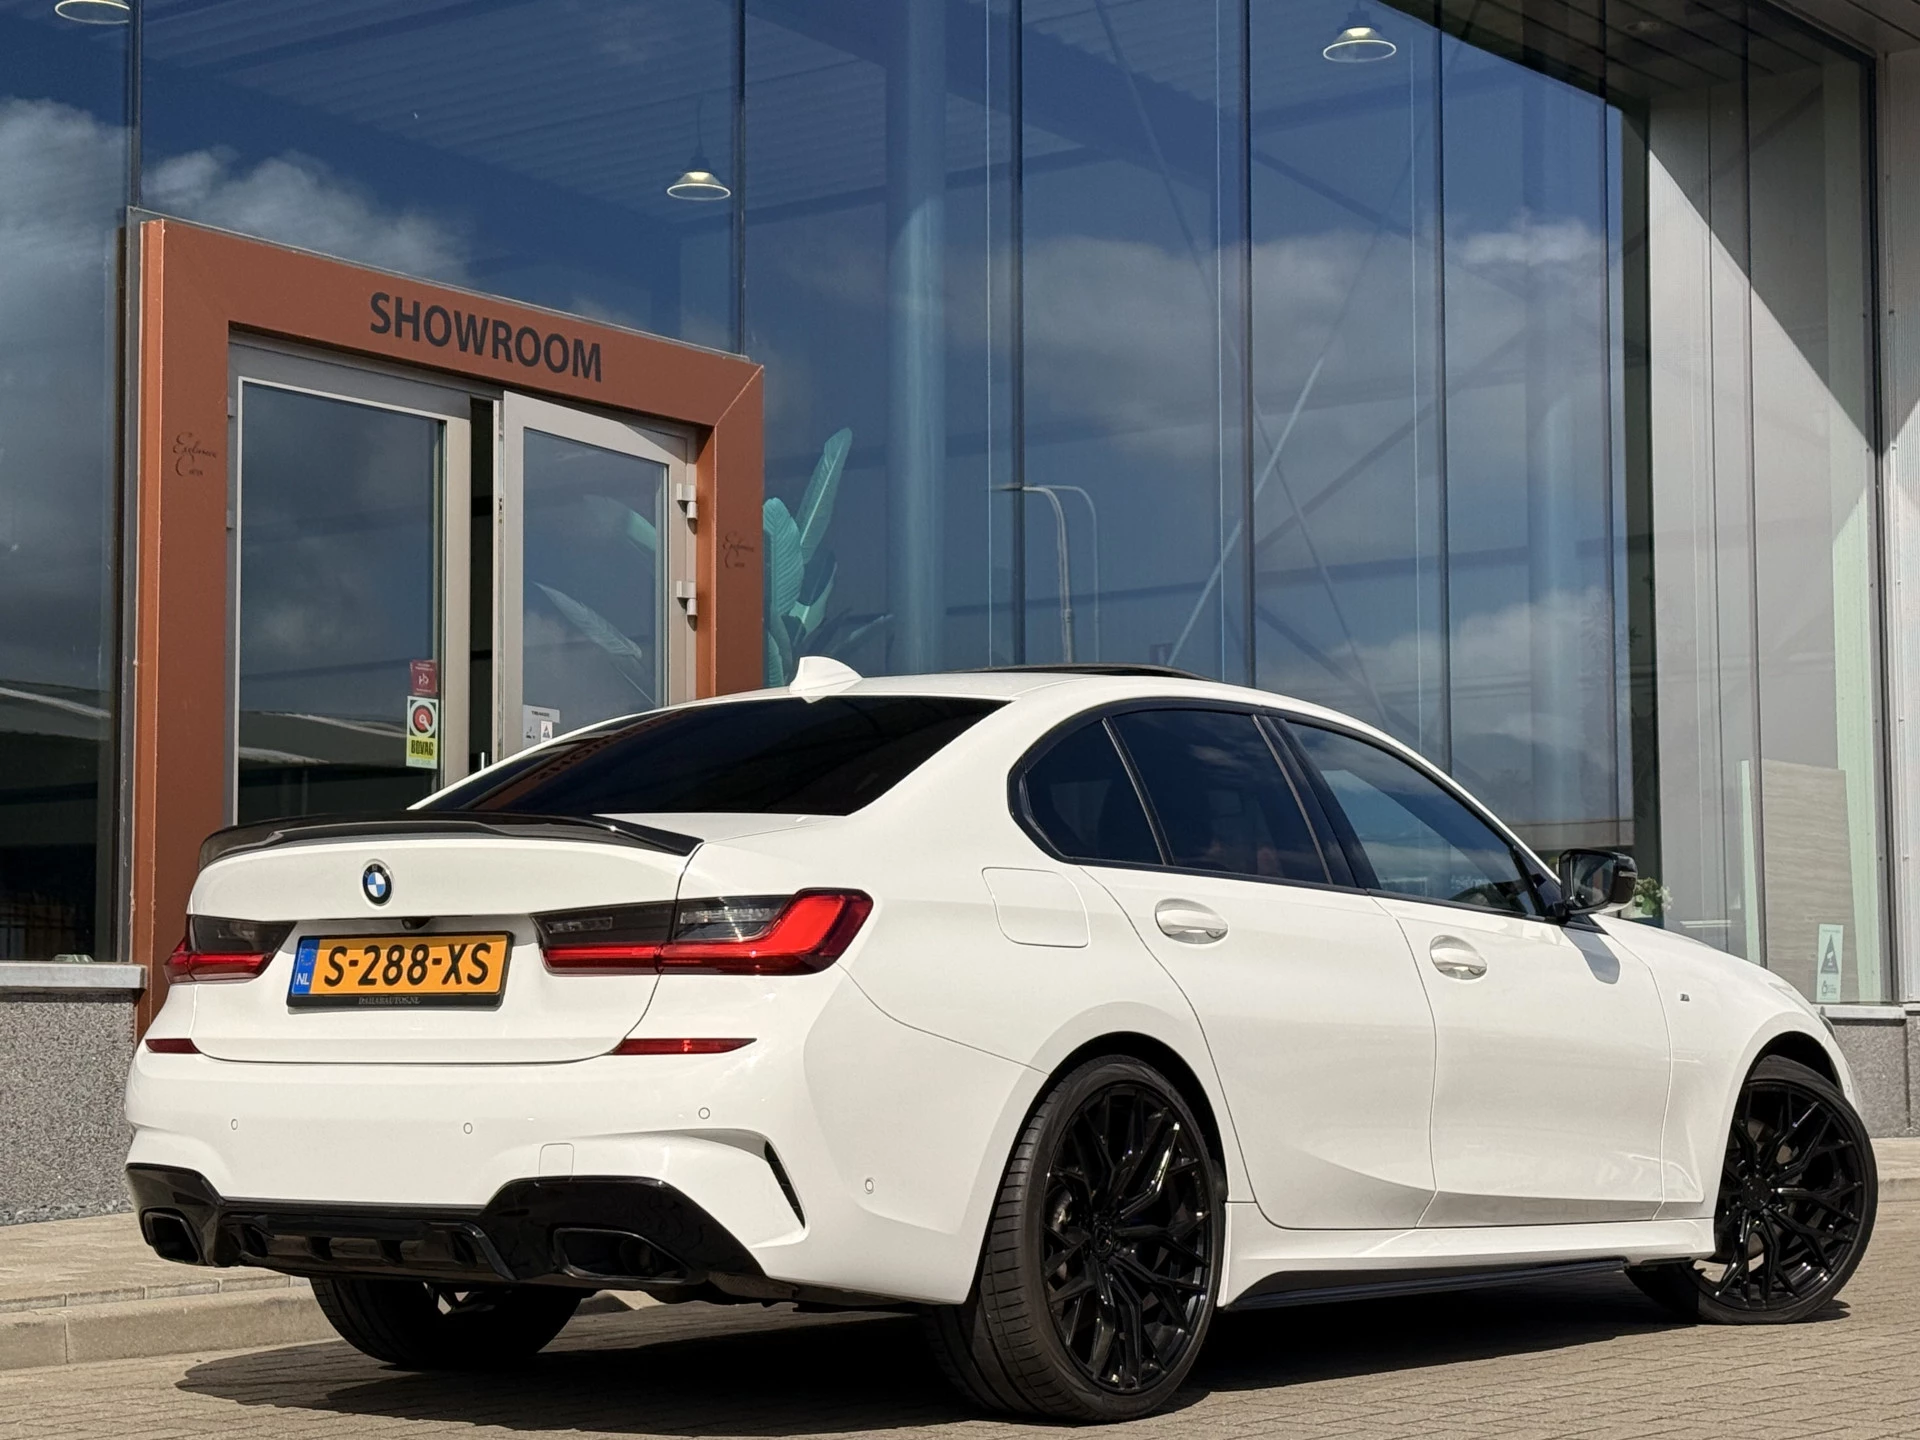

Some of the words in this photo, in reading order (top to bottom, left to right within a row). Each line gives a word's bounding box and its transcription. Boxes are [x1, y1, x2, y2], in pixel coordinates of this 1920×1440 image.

[370, 291, 602, 383] SHOWROOM
[410, 739, 434, 757] BOVAG
[296, 972, 310, 986] NL
[324, 943, 492, 988] S-288-XS
